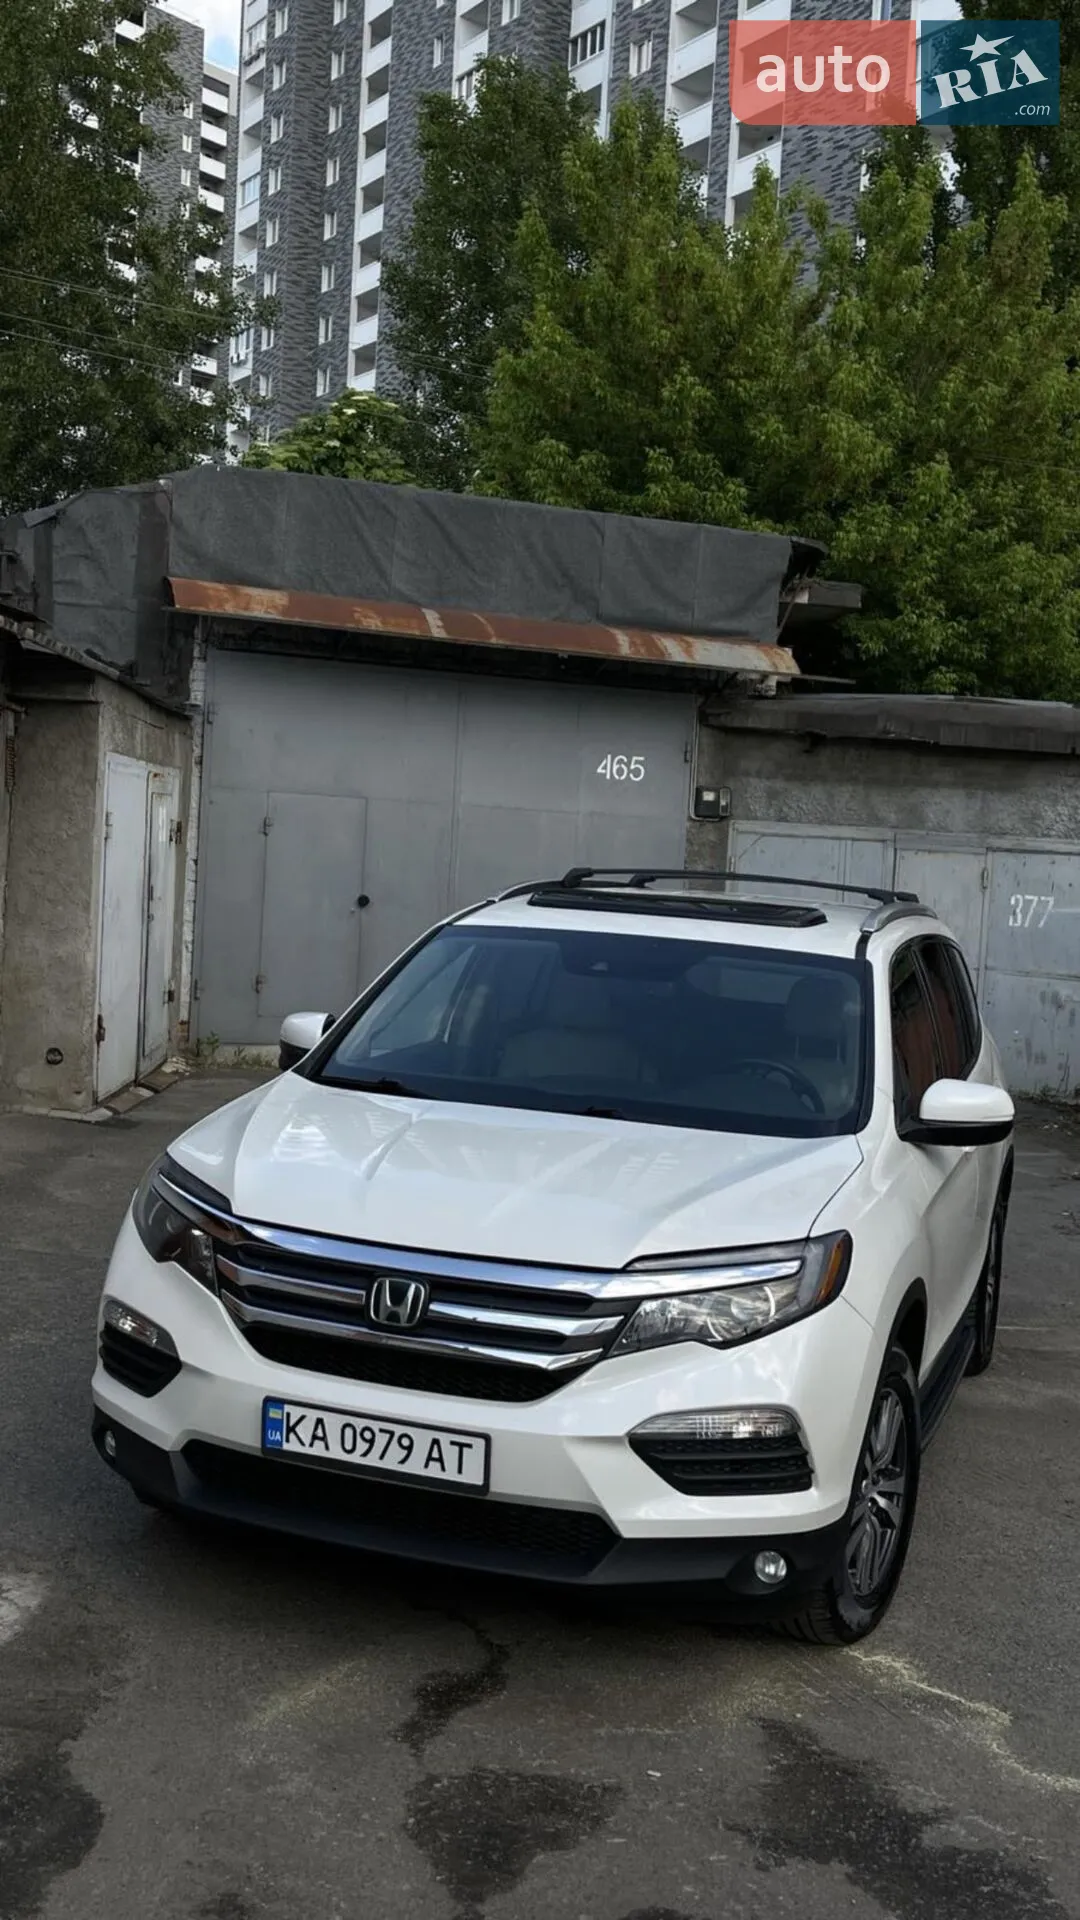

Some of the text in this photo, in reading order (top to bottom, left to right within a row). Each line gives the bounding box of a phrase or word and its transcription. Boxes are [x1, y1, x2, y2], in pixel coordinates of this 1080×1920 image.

[596, 753, 645, 782] 465
[1008, 894, 1055, 928] 377
[268, 1429, 282, 1442] UA
[285, 1411, 473, 1475] KA 0979 AT
